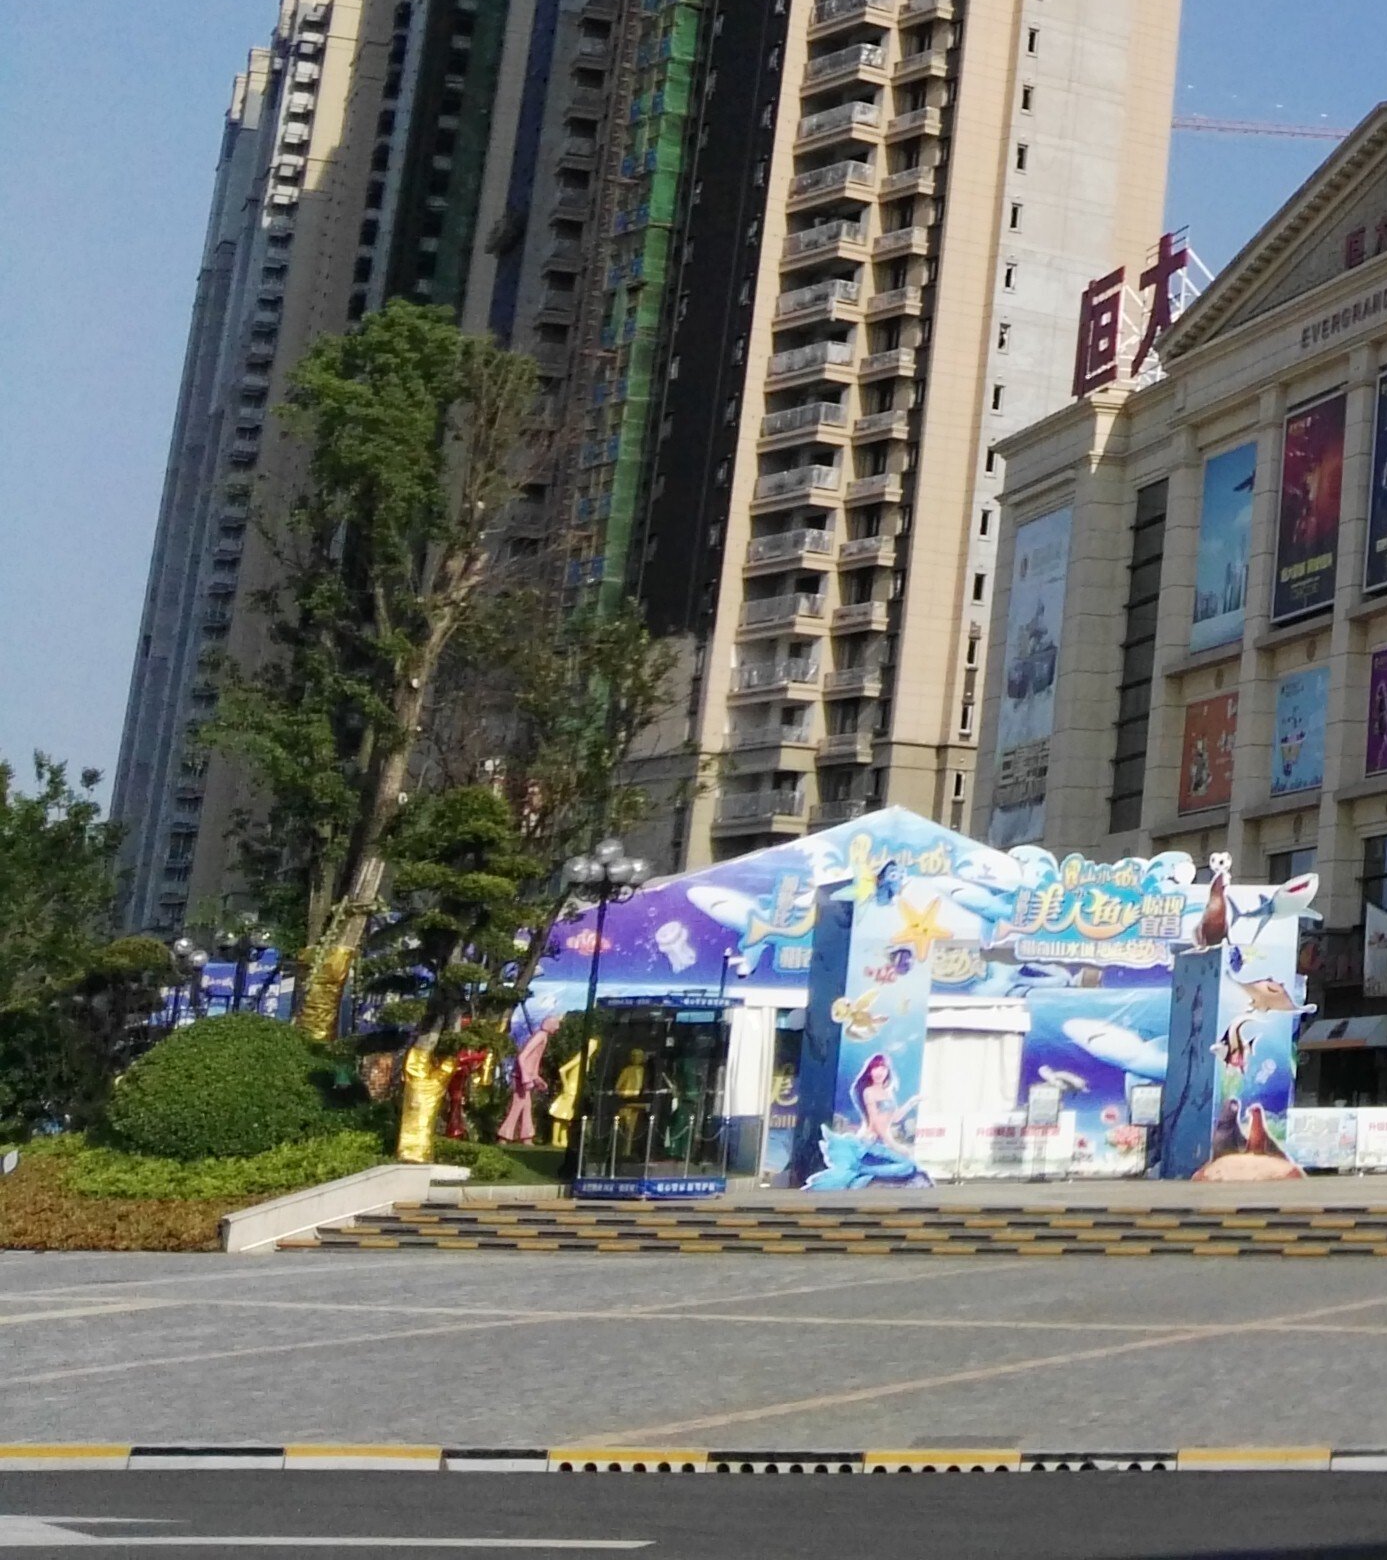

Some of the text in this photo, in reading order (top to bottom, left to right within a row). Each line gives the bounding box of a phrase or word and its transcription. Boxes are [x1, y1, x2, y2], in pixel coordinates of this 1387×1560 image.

[1073, 233, 1187, 399] 恒大
[1141, 896, 1185, 917] 惊现
[1140, 915, 1182, 938] 宜昌
